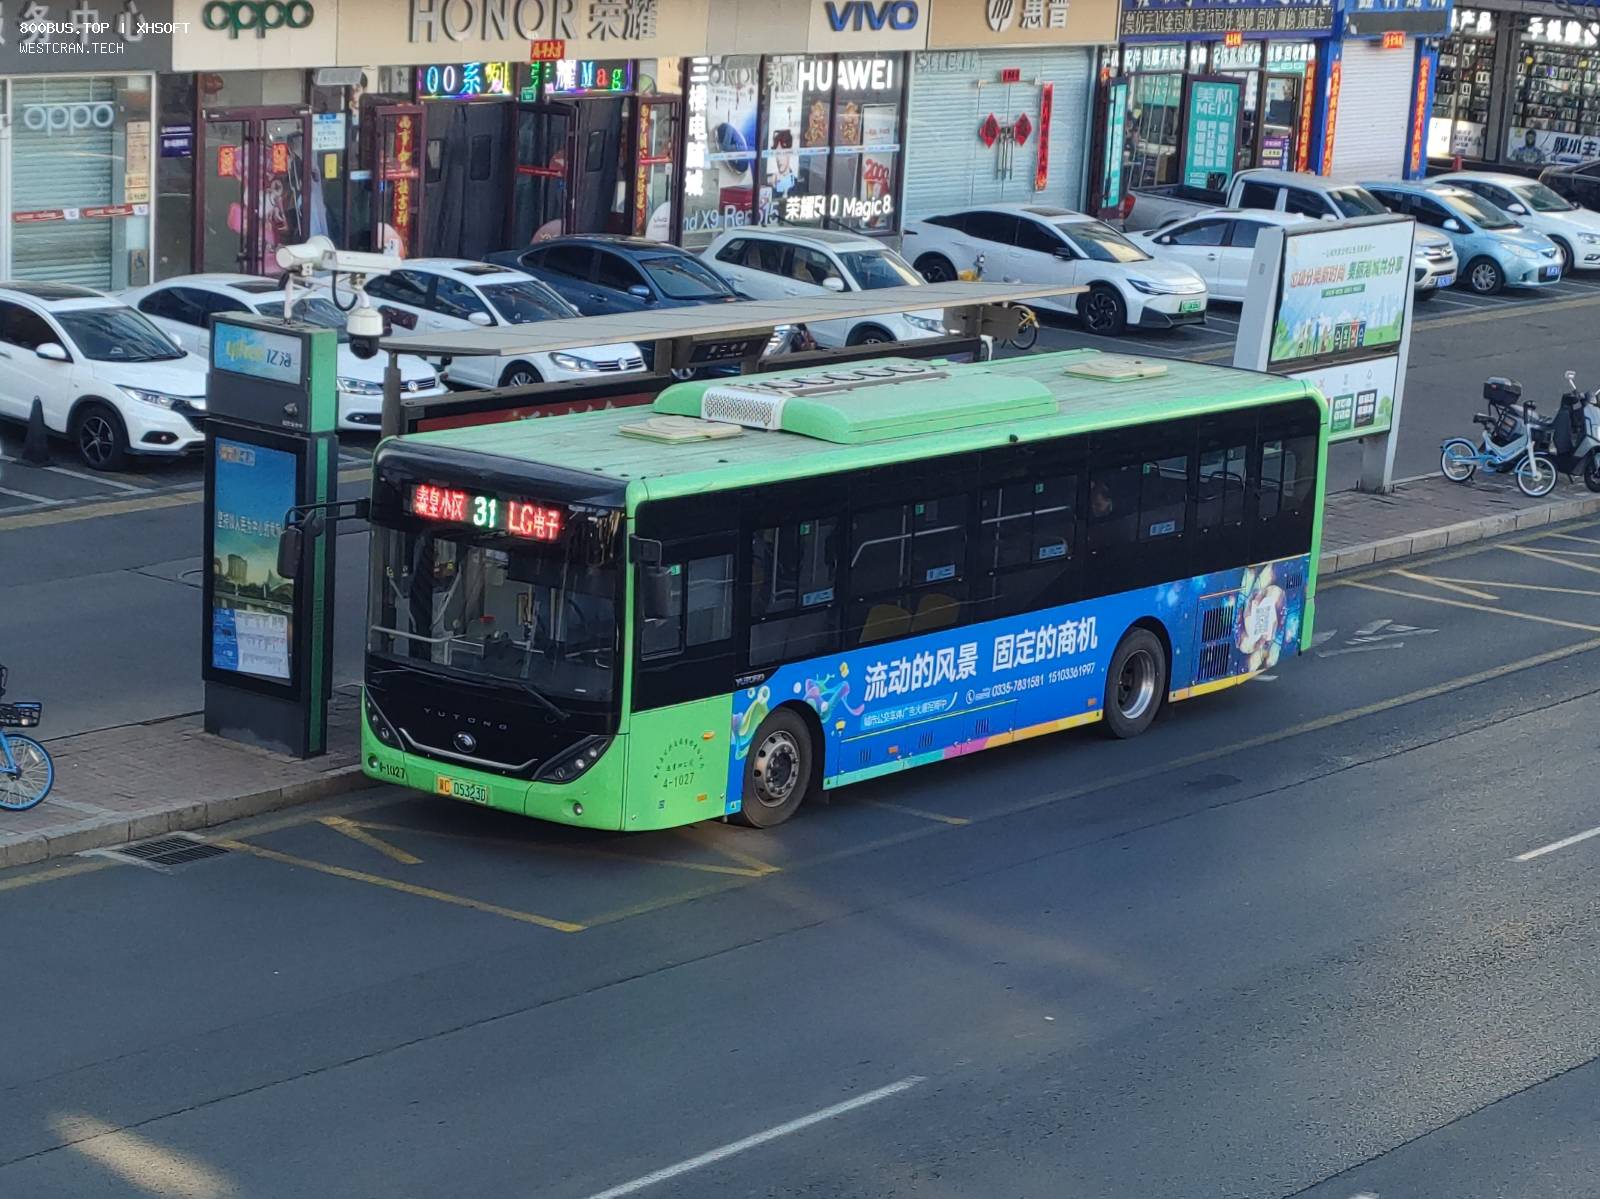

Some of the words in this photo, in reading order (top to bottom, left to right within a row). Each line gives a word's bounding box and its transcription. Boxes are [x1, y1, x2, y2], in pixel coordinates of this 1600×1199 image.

[0, 0, 147, 45] 务中心
[409, 0, 579, 42] HONOR
[587, 0, 658, 41] 荣耀
[1451, 9, 1492, 33] 产品
[798, 59, 893, 93] HUAWEI
[843, 194, 891, 220] Magic8
[473, 495, 496, 529] 31
[508, 500, 561, 540] LG电子
[864, 641, 979, 702] 流动的风景
[992, 615, 1098, 673] 固定的商机
[423, 707, 507, 731] YUTONG
[662, 772, 695, 789] 4-1027
